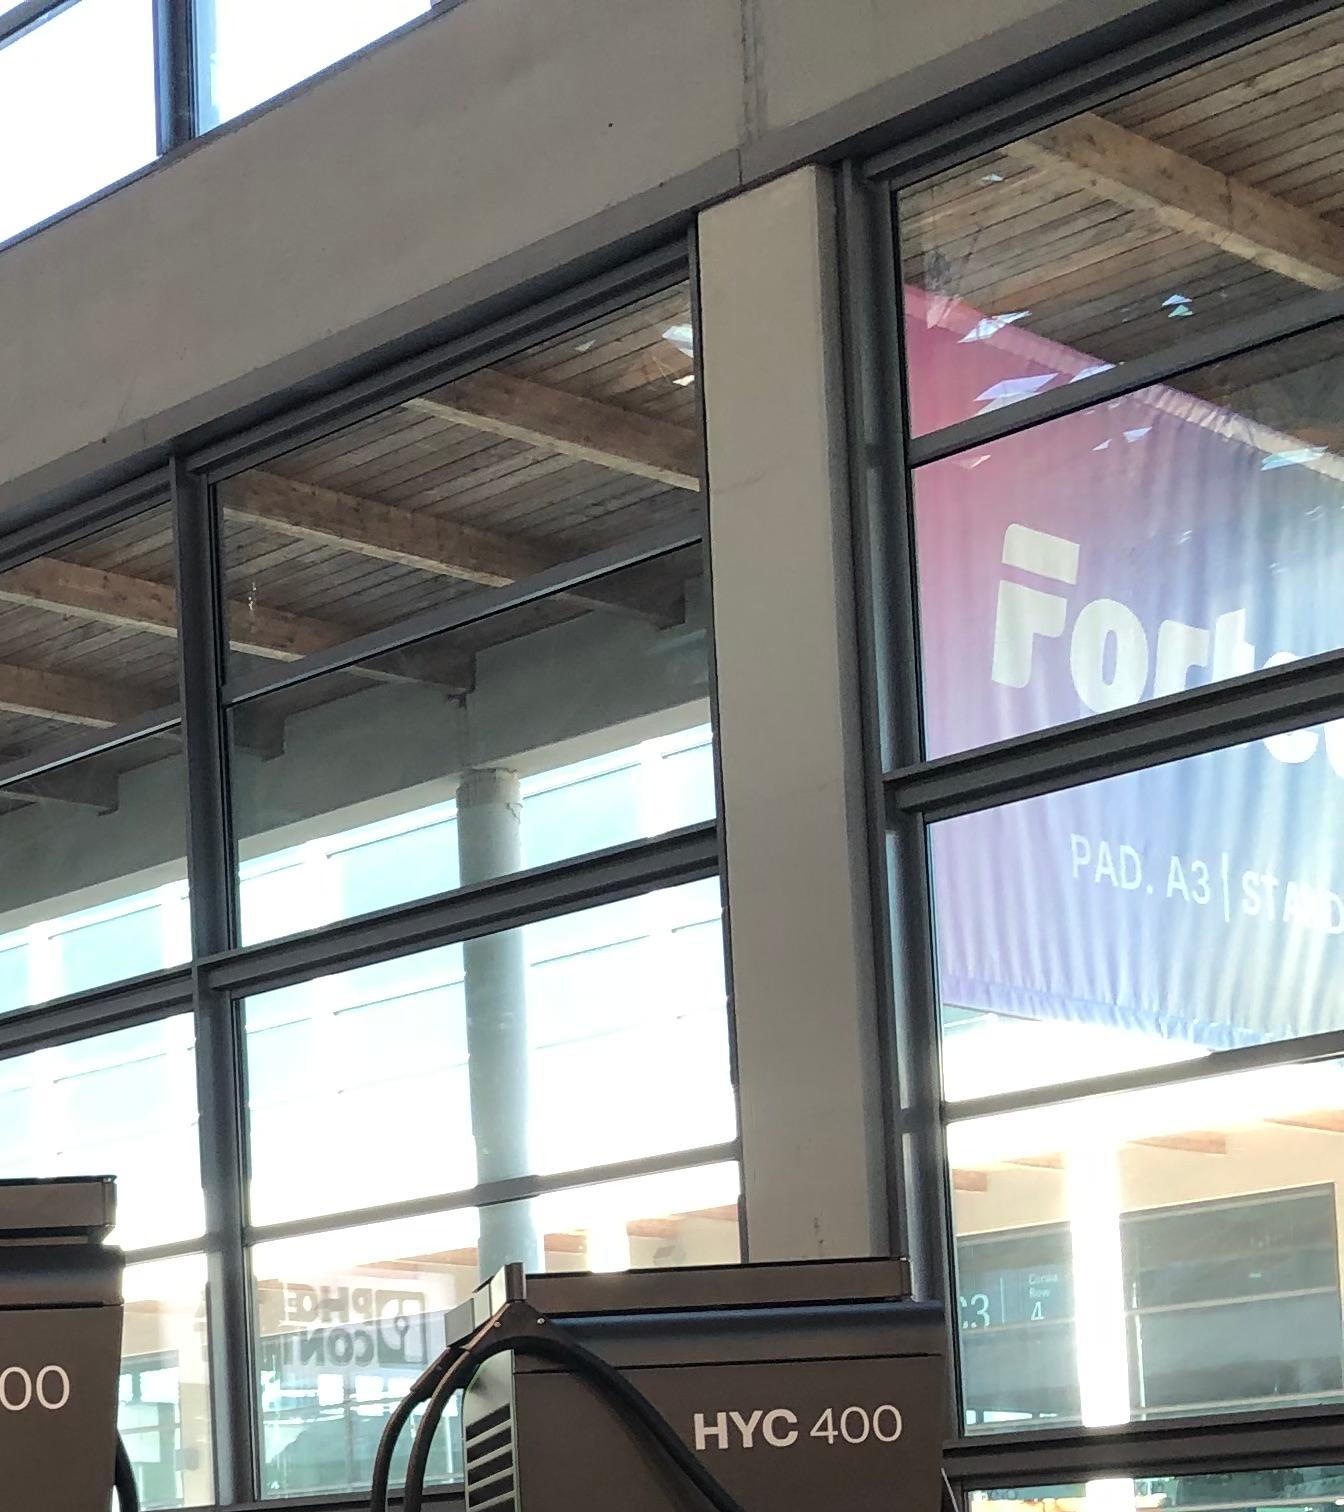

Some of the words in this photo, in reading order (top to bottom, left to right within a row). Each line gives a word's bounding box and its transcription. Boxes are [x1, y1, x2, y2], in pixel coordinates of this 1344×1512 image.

[1070, 833, 1154, 894] PAD.
[1165, 855, 1211, 905] A3
[692, 1407, 799, 1451] HYC
[809, 1403, 904, 1446] 400
